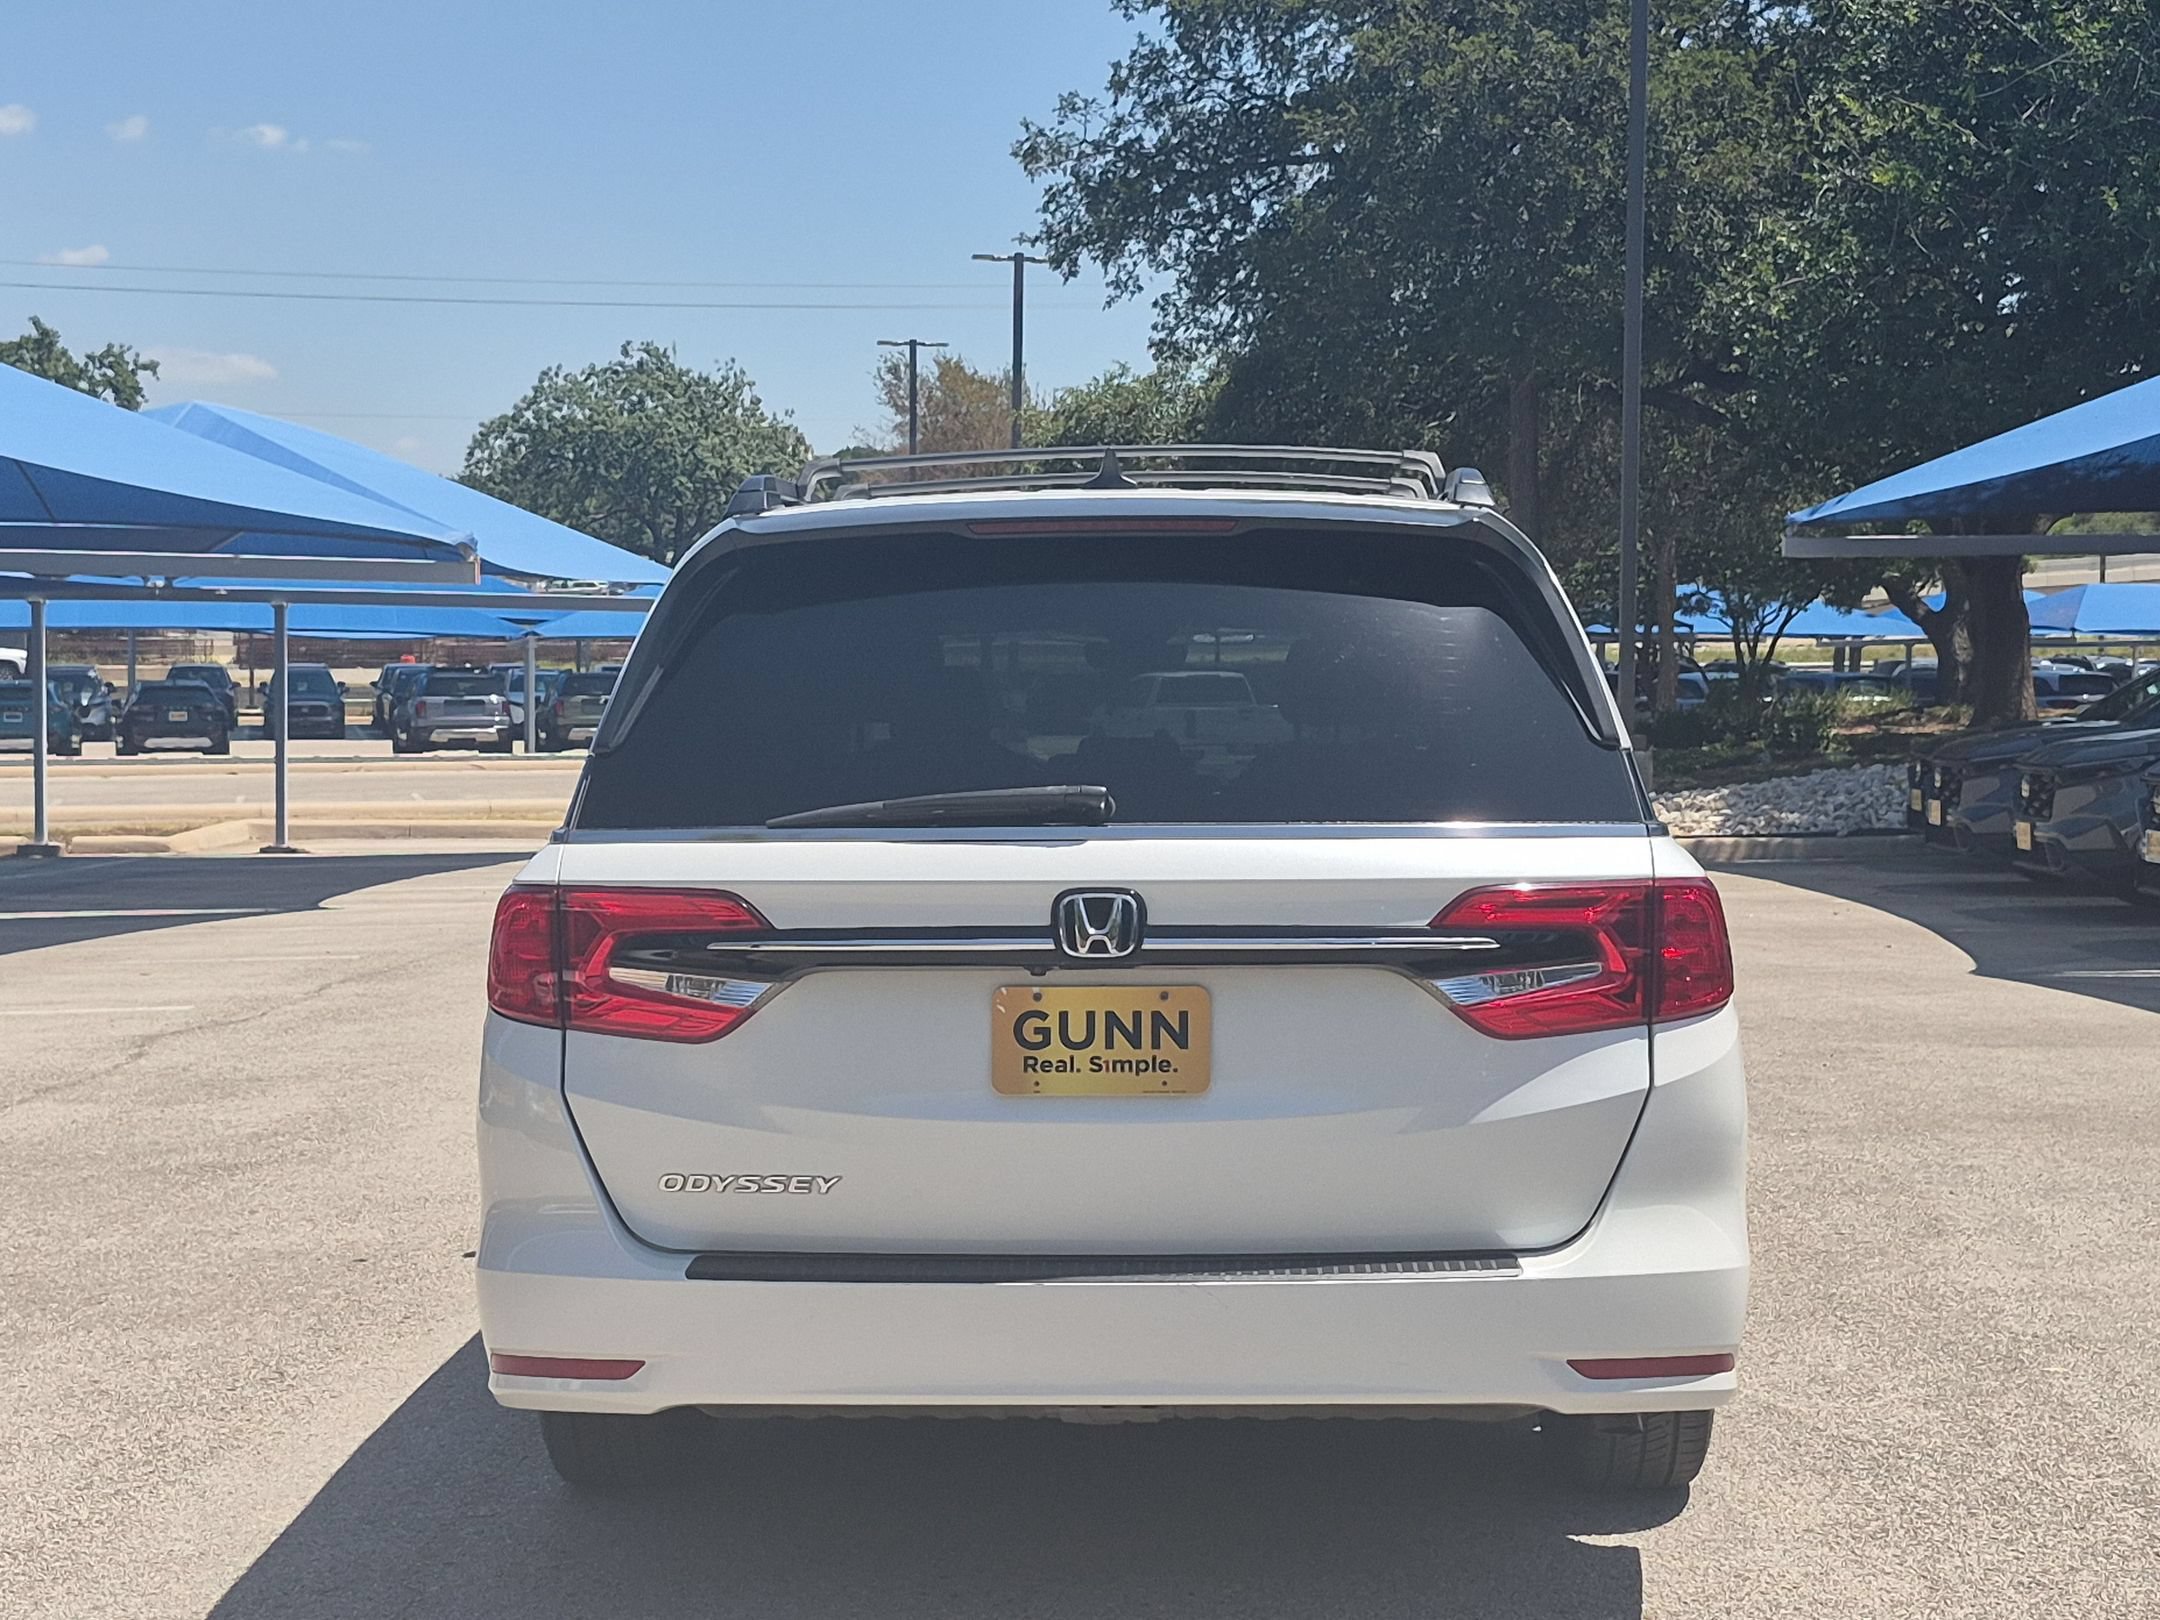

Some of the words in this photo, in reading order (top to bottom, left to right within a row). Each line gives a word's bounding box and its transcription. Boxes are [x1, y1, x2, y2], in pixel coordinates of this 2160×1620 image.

[1013, 1010, 1189, 1050] GUNN
[1023, 1055, 1081, 1073] Real.
[659, 1173, 842, 1194] ODYSSEY
